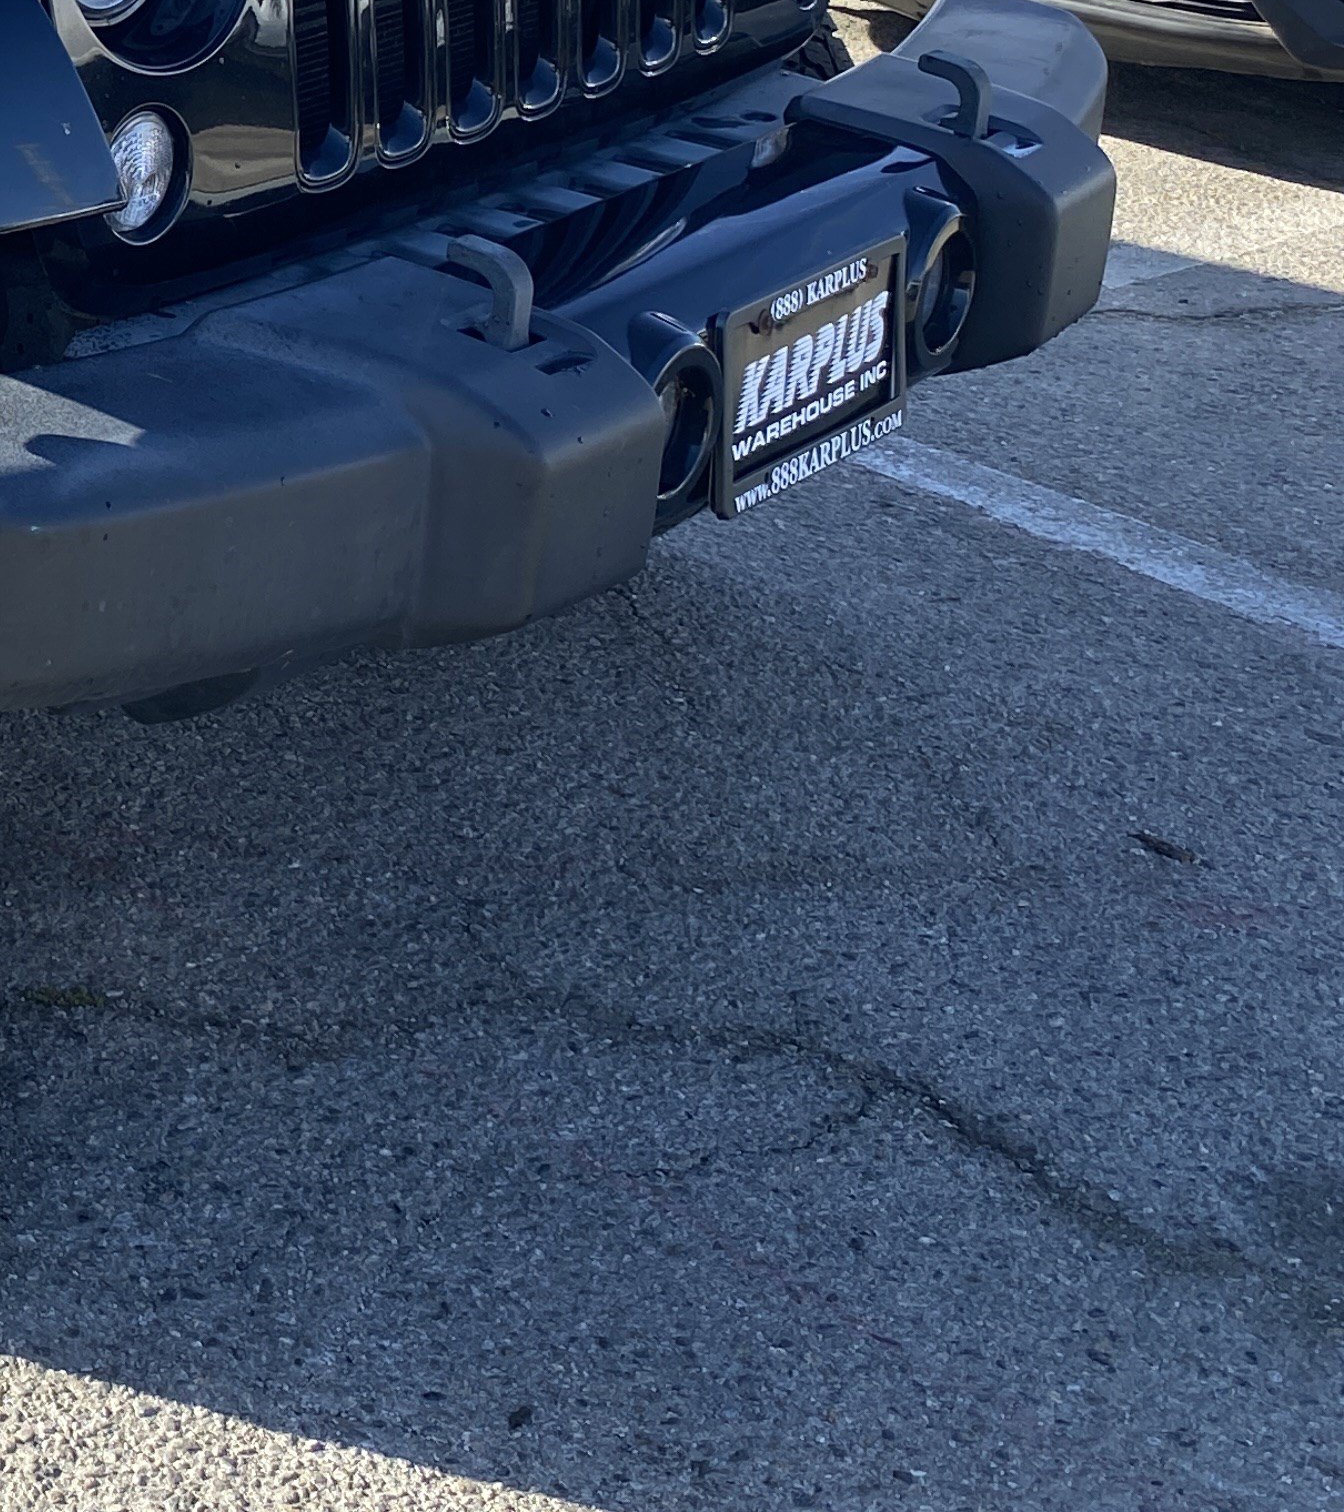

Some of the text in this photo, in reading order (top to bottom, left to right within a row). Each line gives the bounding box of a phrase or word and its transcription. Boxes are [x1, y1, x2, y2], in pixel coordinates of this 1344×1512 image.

[770, 257, 868, 322] (888) KARPLUS
[731, 359, 888, 462] WAREHOUSE INC
[733, 290, 890, 435] KARPLUS
